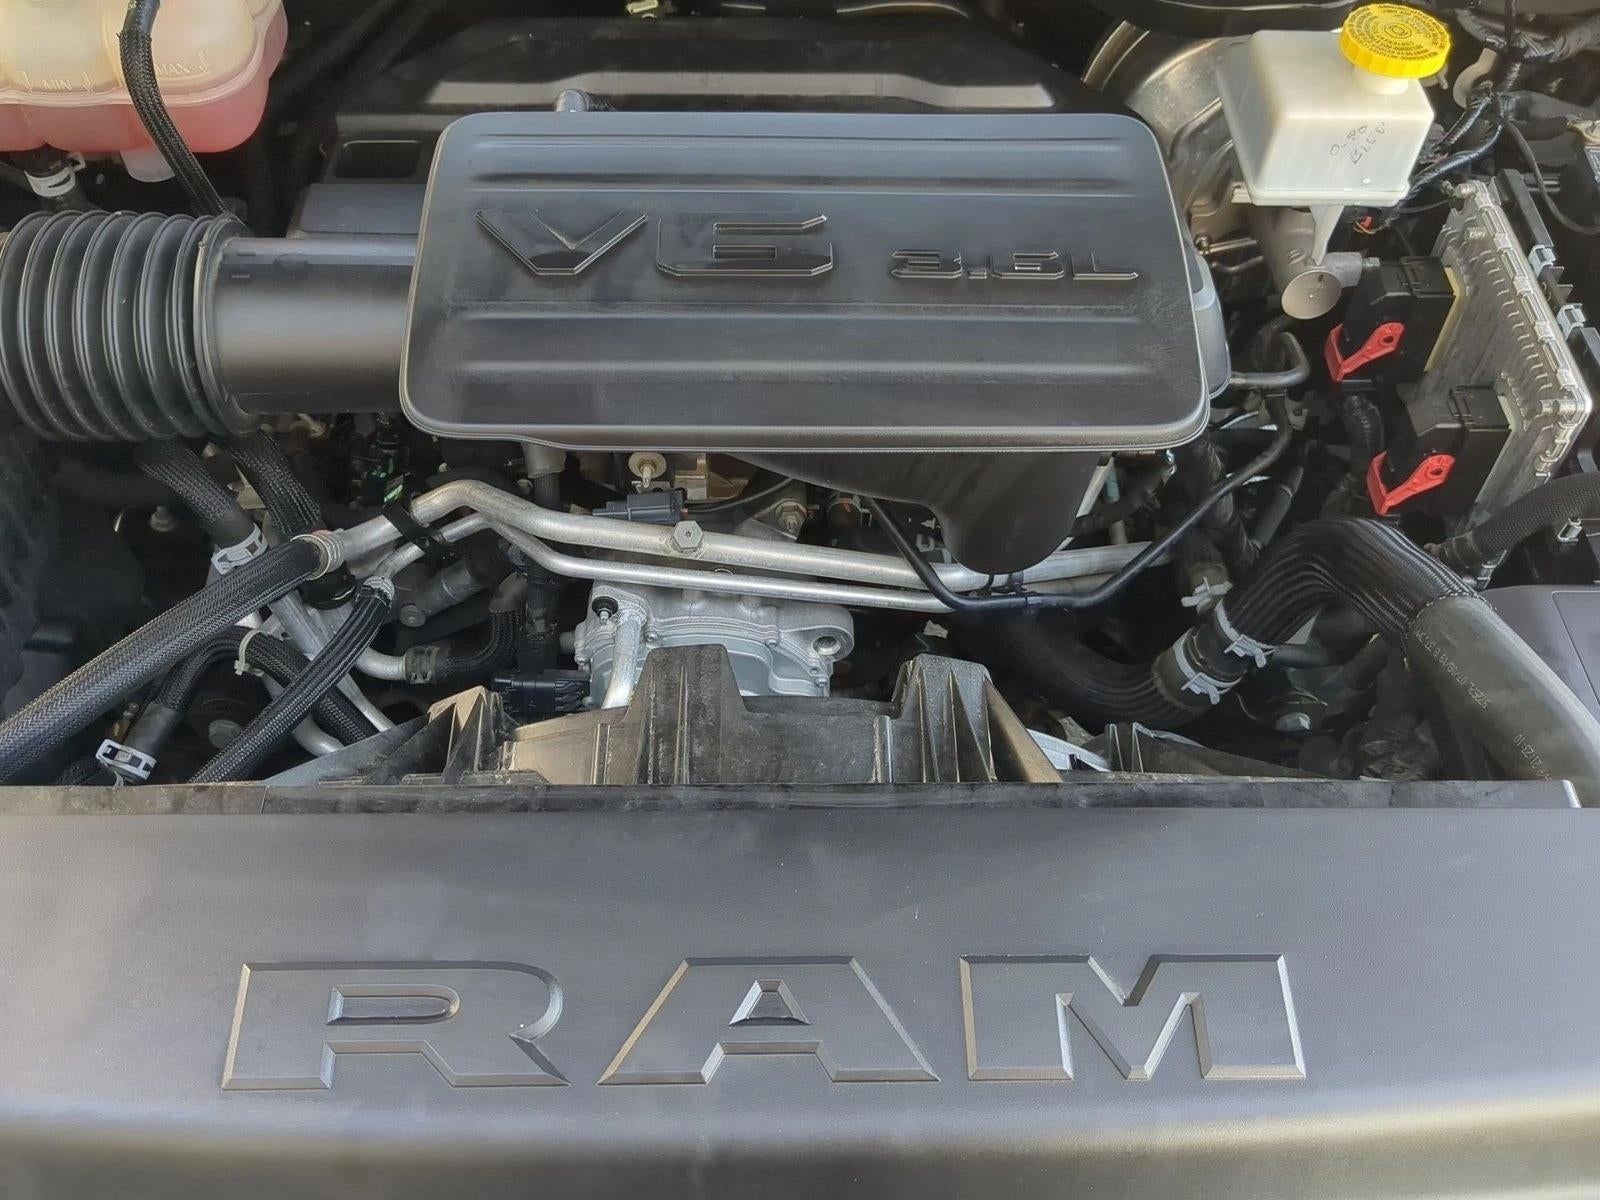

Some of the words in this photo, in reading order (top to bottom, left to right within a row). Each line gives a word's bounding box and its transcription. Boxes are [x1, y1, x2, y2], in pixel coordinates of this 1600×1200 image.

[475, 209, 833, 276] V6
[891, 249, 1140, 280] 3.6L
[222, 954, 1307, 1090] RAM
